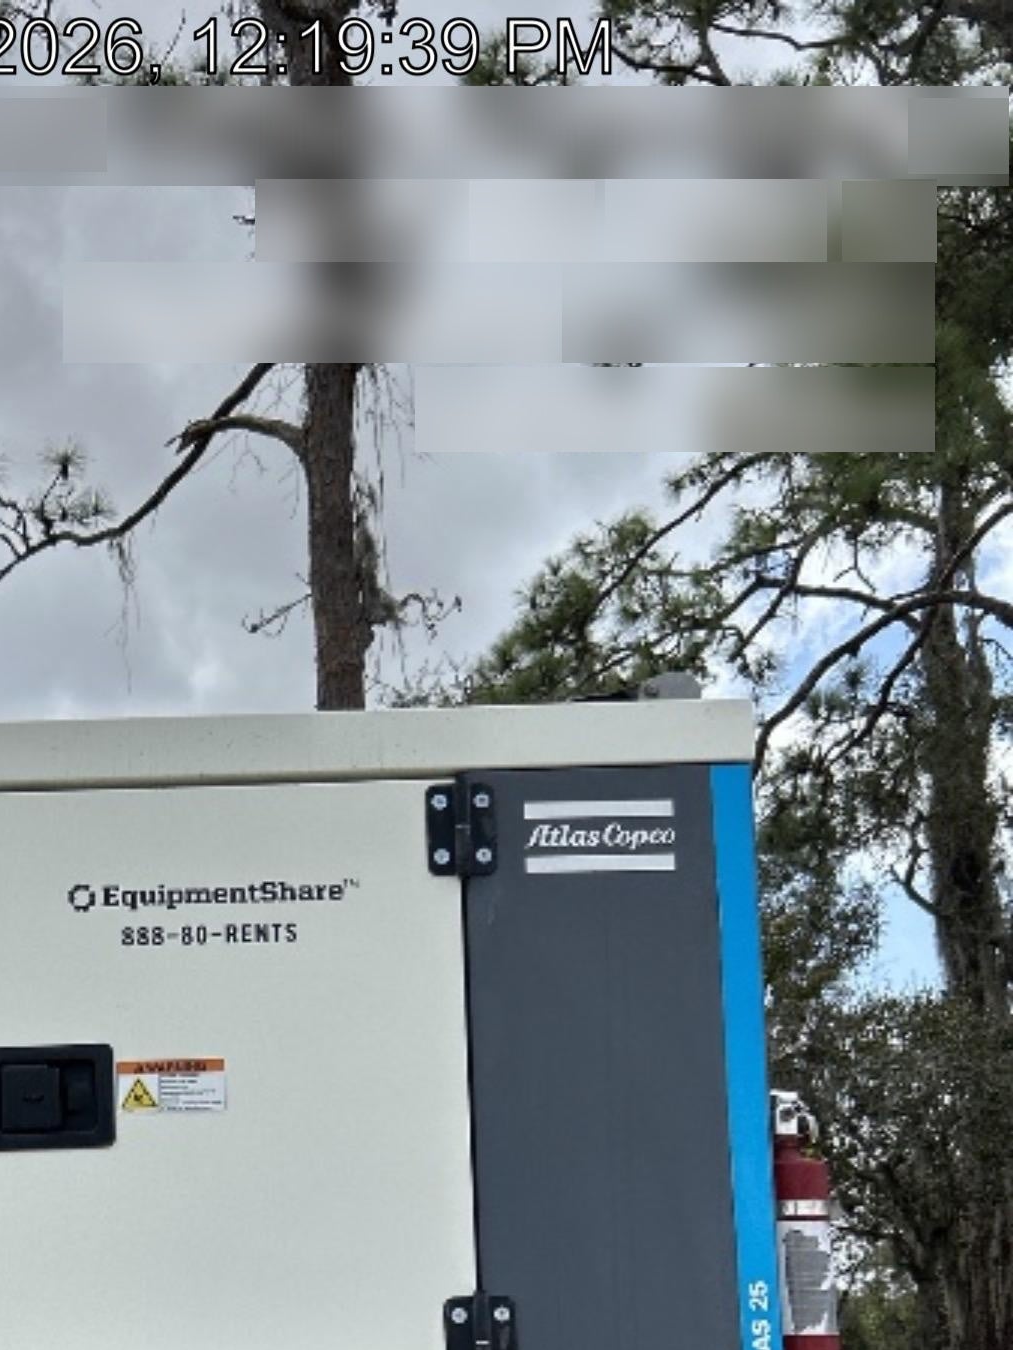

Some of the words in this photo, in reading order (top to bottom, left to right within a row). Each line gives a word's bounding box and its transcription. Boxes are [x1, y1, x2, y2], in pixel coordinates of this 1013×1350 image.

[525, 824, 600, 849] Atlas
[602, 822, 676, 850] Copco
[121, 923, 298, 945] 888-80-RENTS
[749, 1281, 769, 1310] 25
